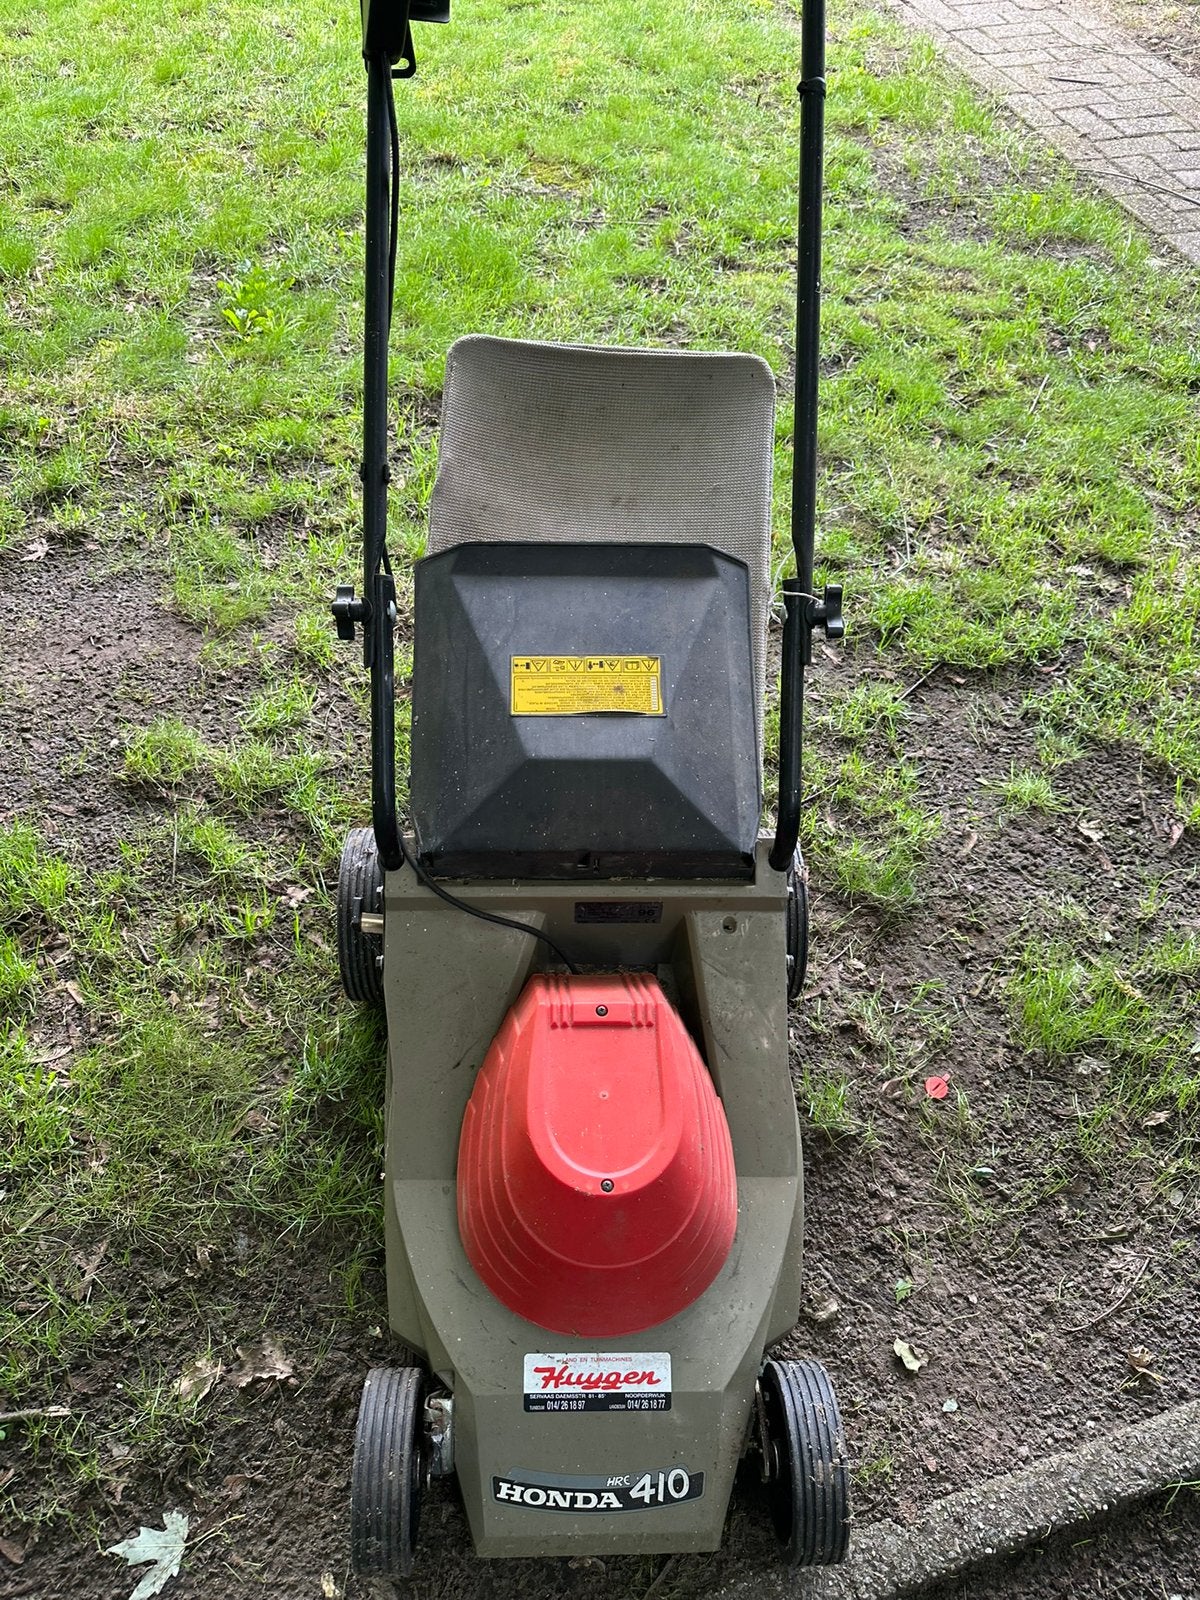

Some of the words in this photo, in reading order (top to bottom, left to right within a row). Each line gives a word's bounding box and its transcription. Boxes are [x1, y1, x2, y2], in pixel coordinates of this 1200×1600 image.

[533, 1365, 662, 1390] Huygen
[546, 1400, 560, 1410] 014/
[560, 1400, 568, 1410] 26
[569, 1400, 577, 1410] 18
[577, 1400, 586, 1410] 97
[627, 1399, 641, 1409] 014/
[641, 1399, 649, 1409] 26
[650, 1399, 658, 1409] 18
[658, 1399, 666, 1409] 77
[496, 1481, 624, 1509] HONDA
[629, 1468, 690, 1504] 410
